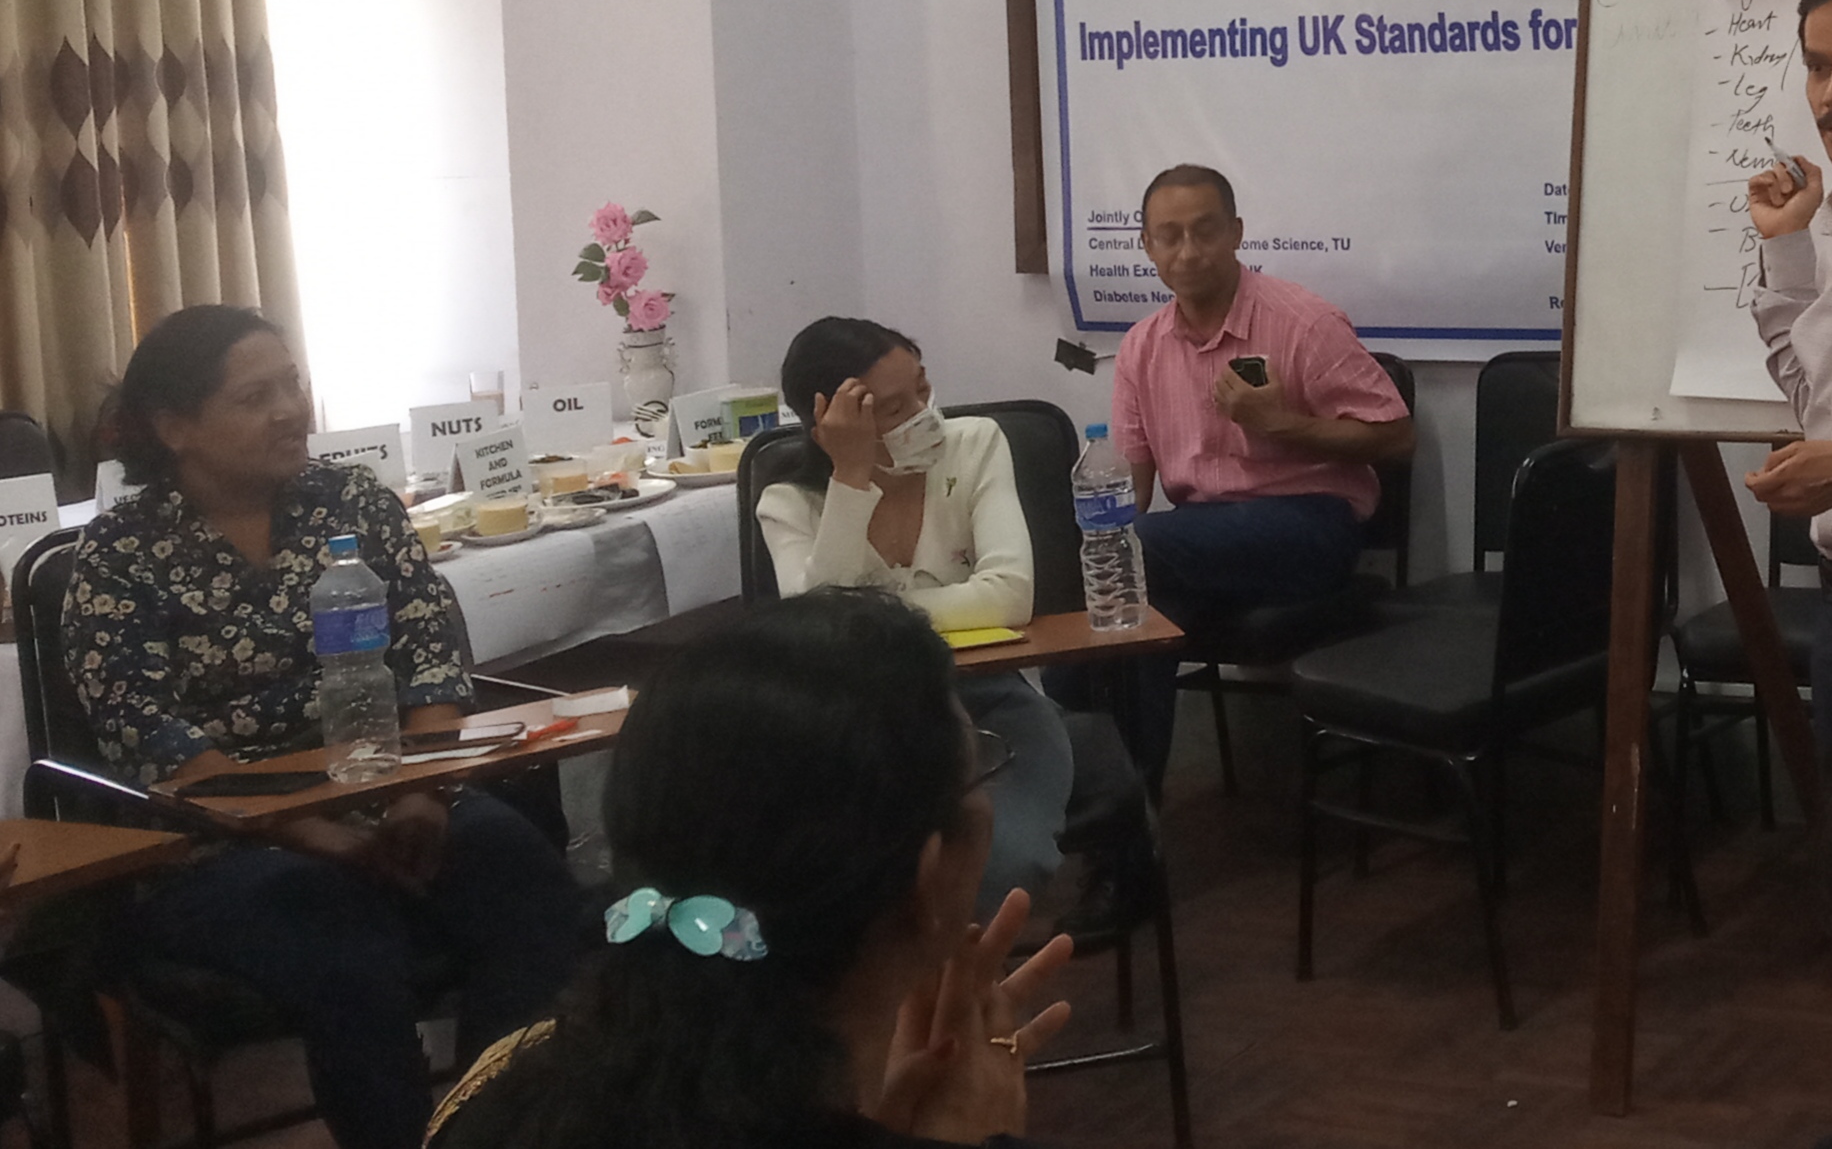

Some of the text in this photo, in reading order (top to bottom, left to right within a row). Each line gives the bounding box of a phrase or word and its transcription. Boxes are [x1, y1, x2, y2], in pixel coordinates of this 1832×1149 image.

[1079, 18, 1288, 70] Implementing
[1299, 15, 1347, 57] UK
[1355, 10, 1521, 54] Standards
[1529, 8, 1577, 50] for
[1088, 210, 1130, 226] Jointly
[1089, 237, 1135, 250] Central
[1238, 238, 1269, 251] ome
[1272, 237, 1329, 252] Science,
[1332, 237, 1350, 251] TU
[1090, 264, 1129, 277] Health
[553, 397, 584, 413] OIL
[430, 416, 482, 437] NUTS
[475, 439, 513, 459] KITCHEN
[488, 457, 508, 471] AND
[480, 469, 522, 490] FORMULA
